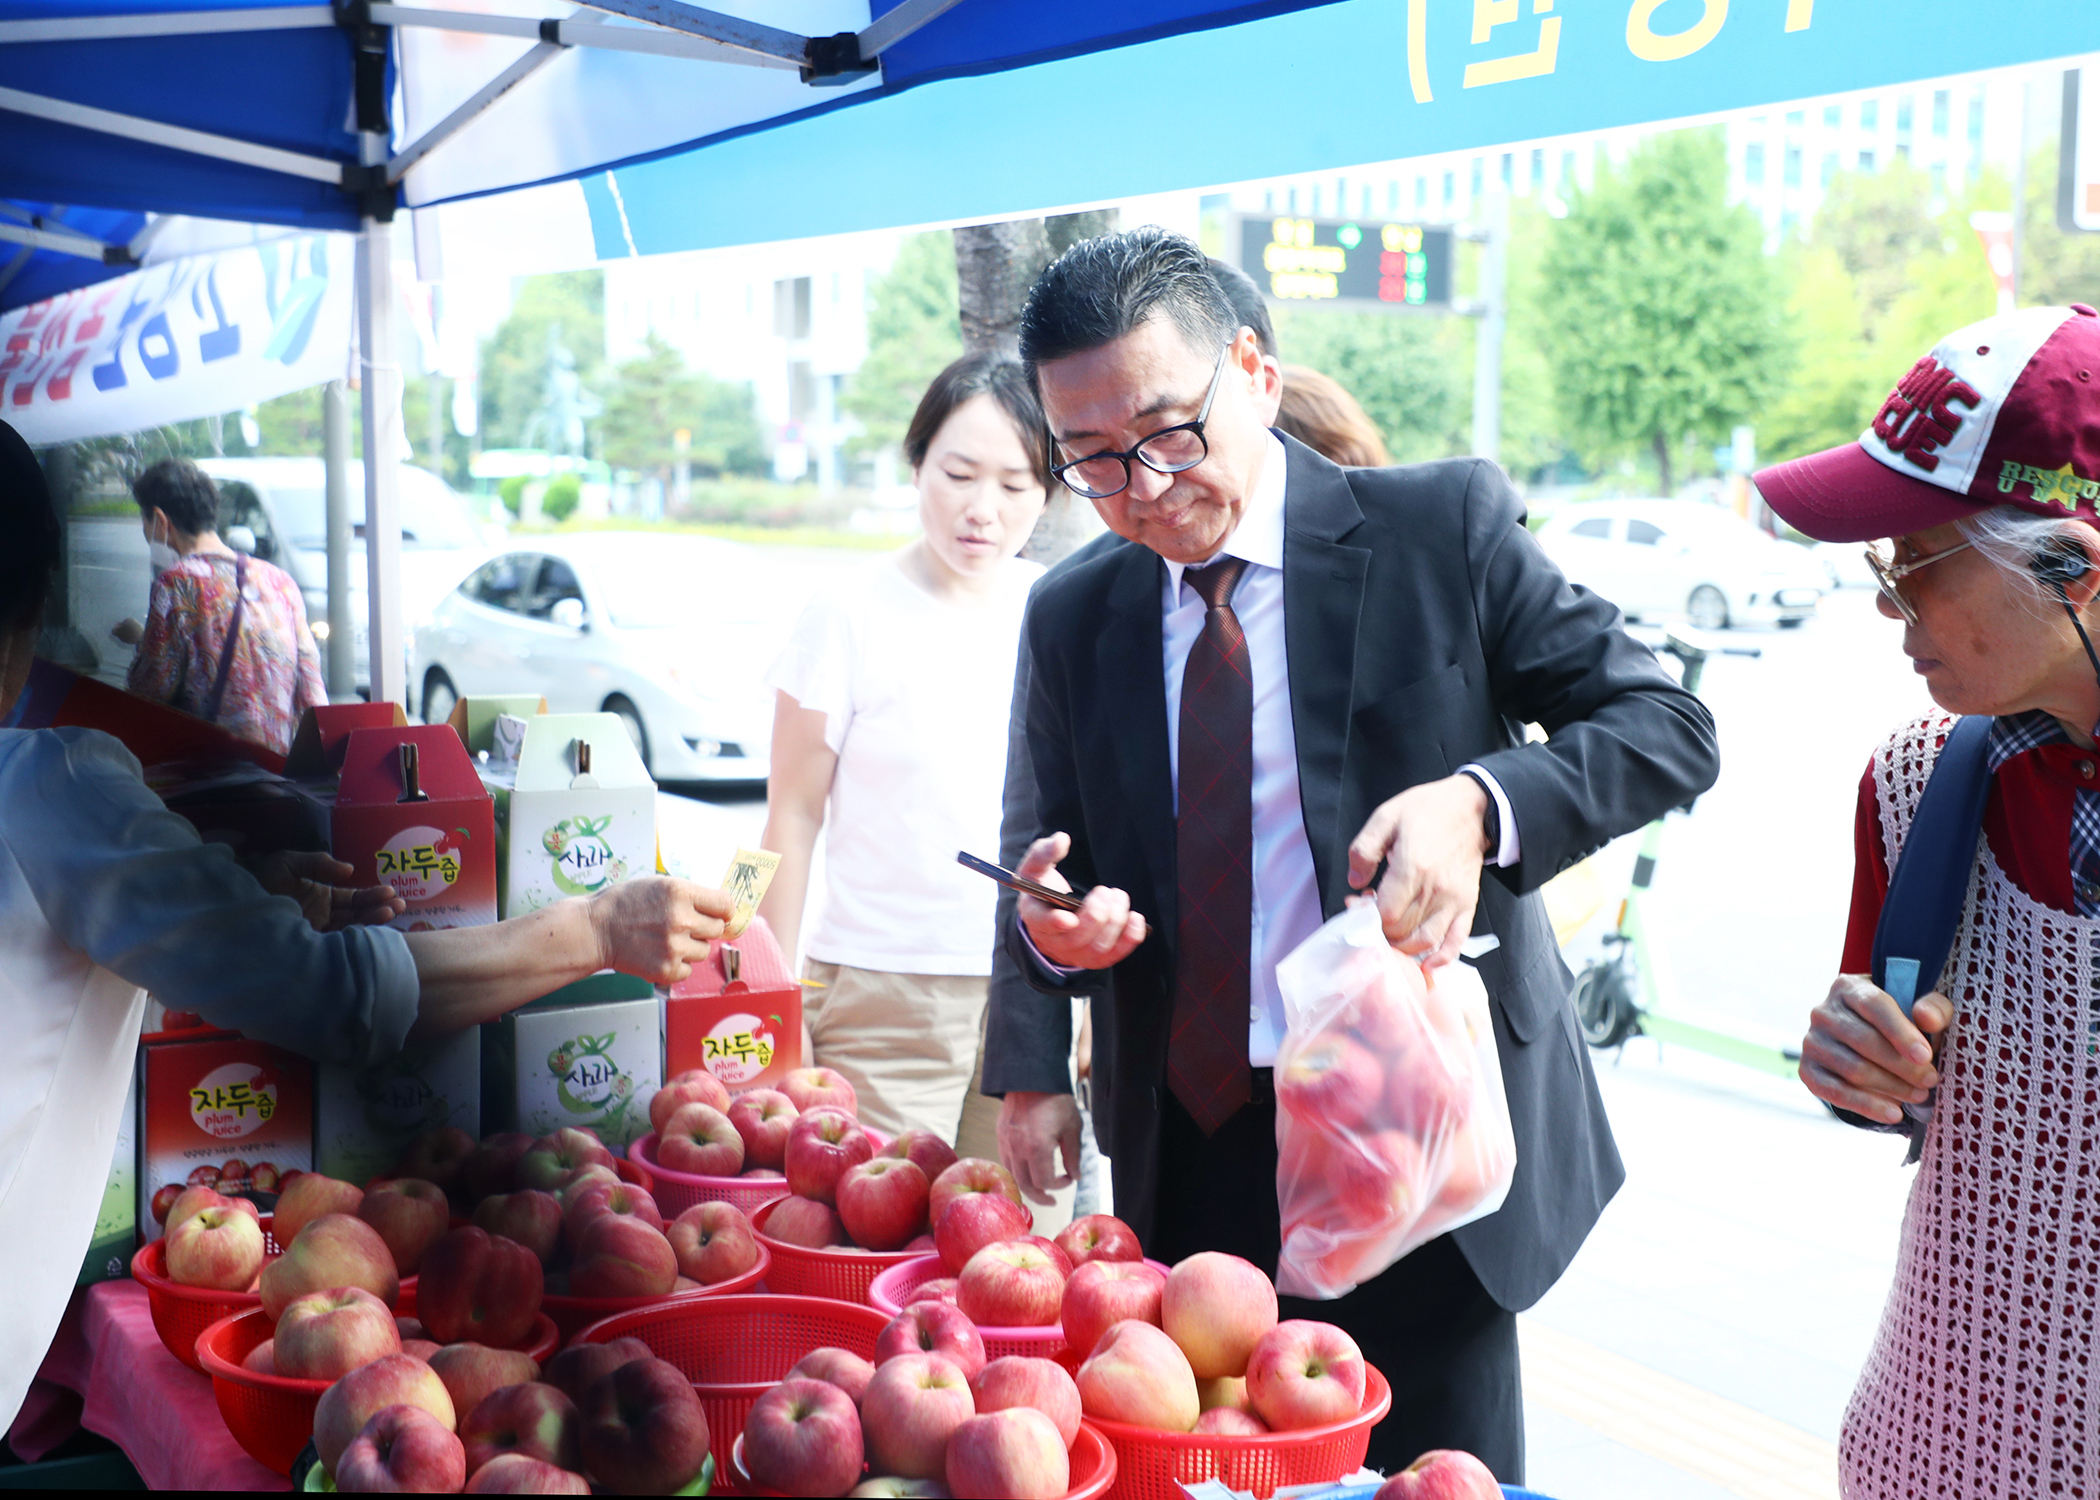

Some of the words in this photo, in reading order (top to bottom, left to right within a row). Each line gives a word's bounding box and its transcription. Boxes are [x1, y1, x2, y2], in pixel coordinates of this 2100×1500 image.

[1871, 388, 1954, 474] CUE
[375, 845, 461, 885] 자두즙
[558, 843, 614, 869] 사과
[755, 856, 777, 870] 50000
[391, 874, 418, 888] plum
[701, 1032, 775, 1068] 자두즙
[564, 1063, 618, 1088] 사과
[715, 1060, 739, 1074] plum
[720, 1070, 745, 1082] juice
[189, 1081, 276, 1121] 자두즙
[205, 1113, 234, 1128] plum
[212, 1122, 242, 1138] juice
